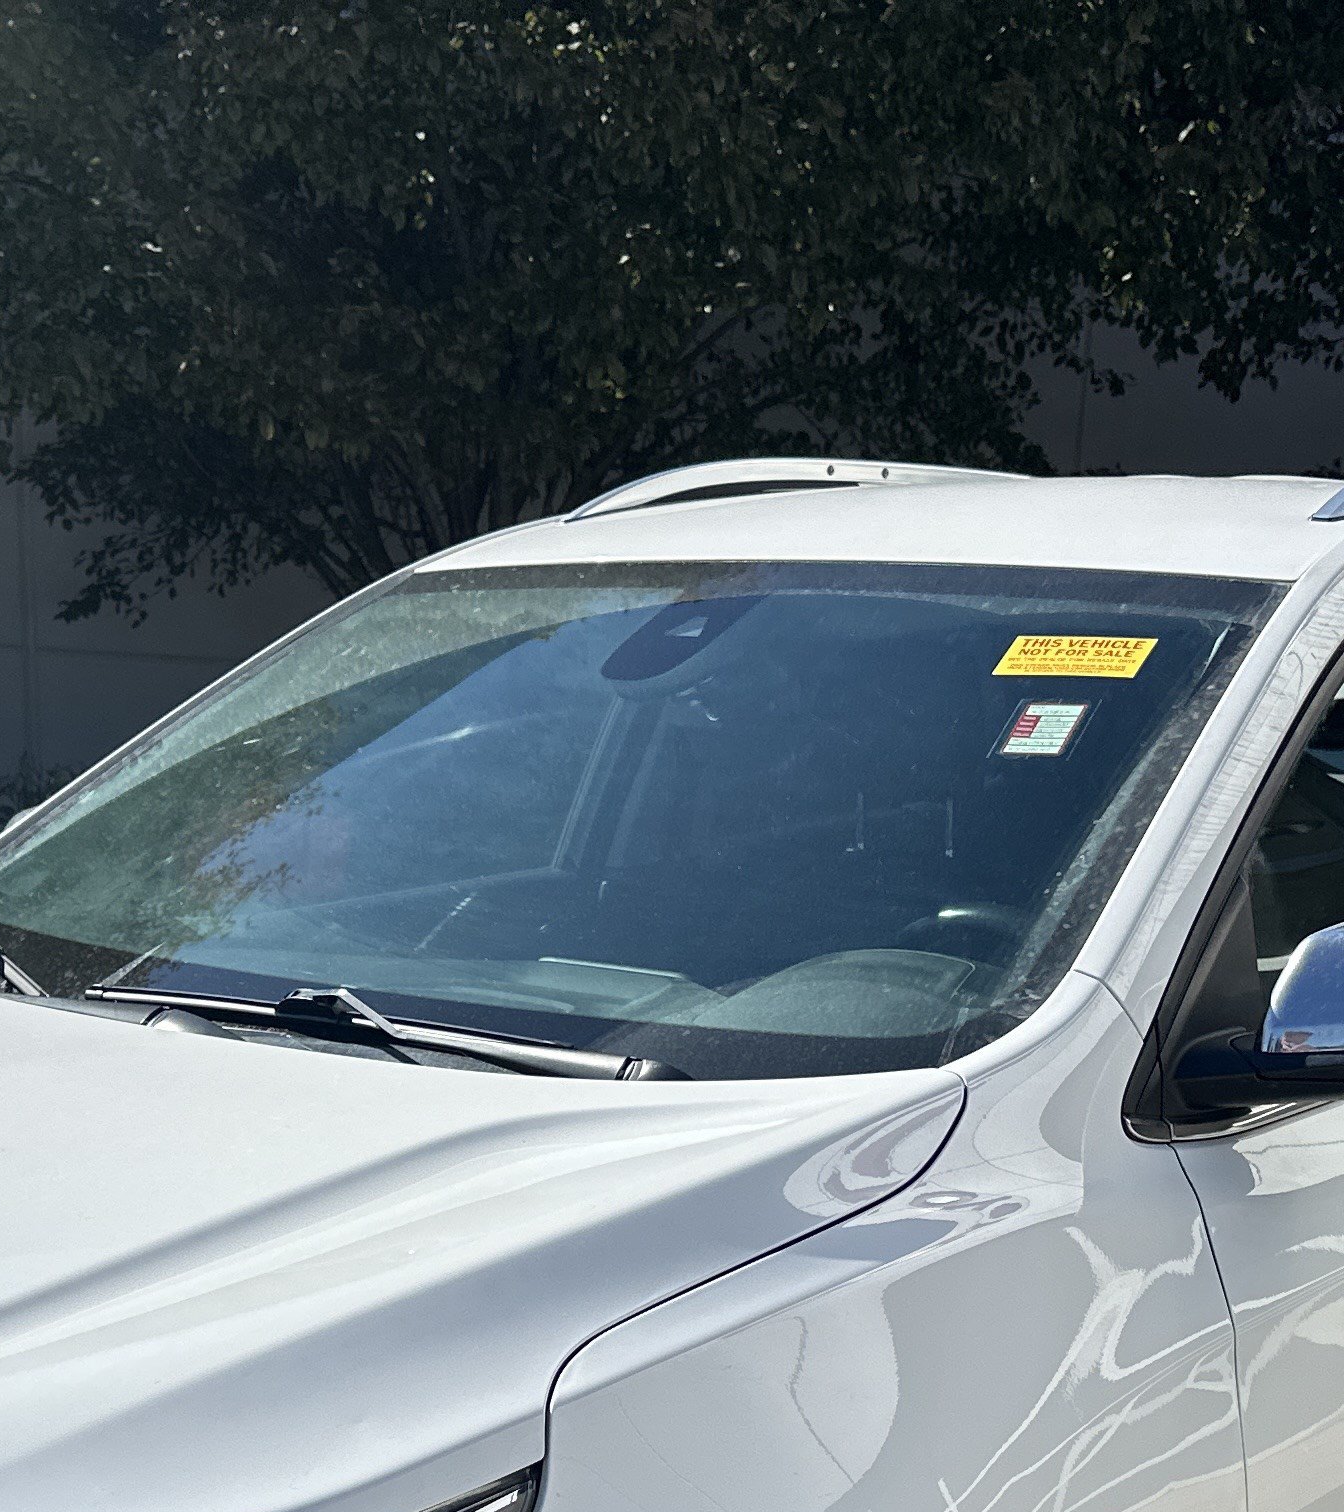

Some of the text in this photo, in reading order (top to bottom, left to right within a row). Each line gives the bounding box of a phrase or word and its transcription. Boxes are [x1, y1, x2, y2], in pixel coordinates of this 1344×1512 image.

[1022, 638, 1147, 650] THIS VEHICLE
[1017, 648, 1135, 658] NOT FOR SALE
